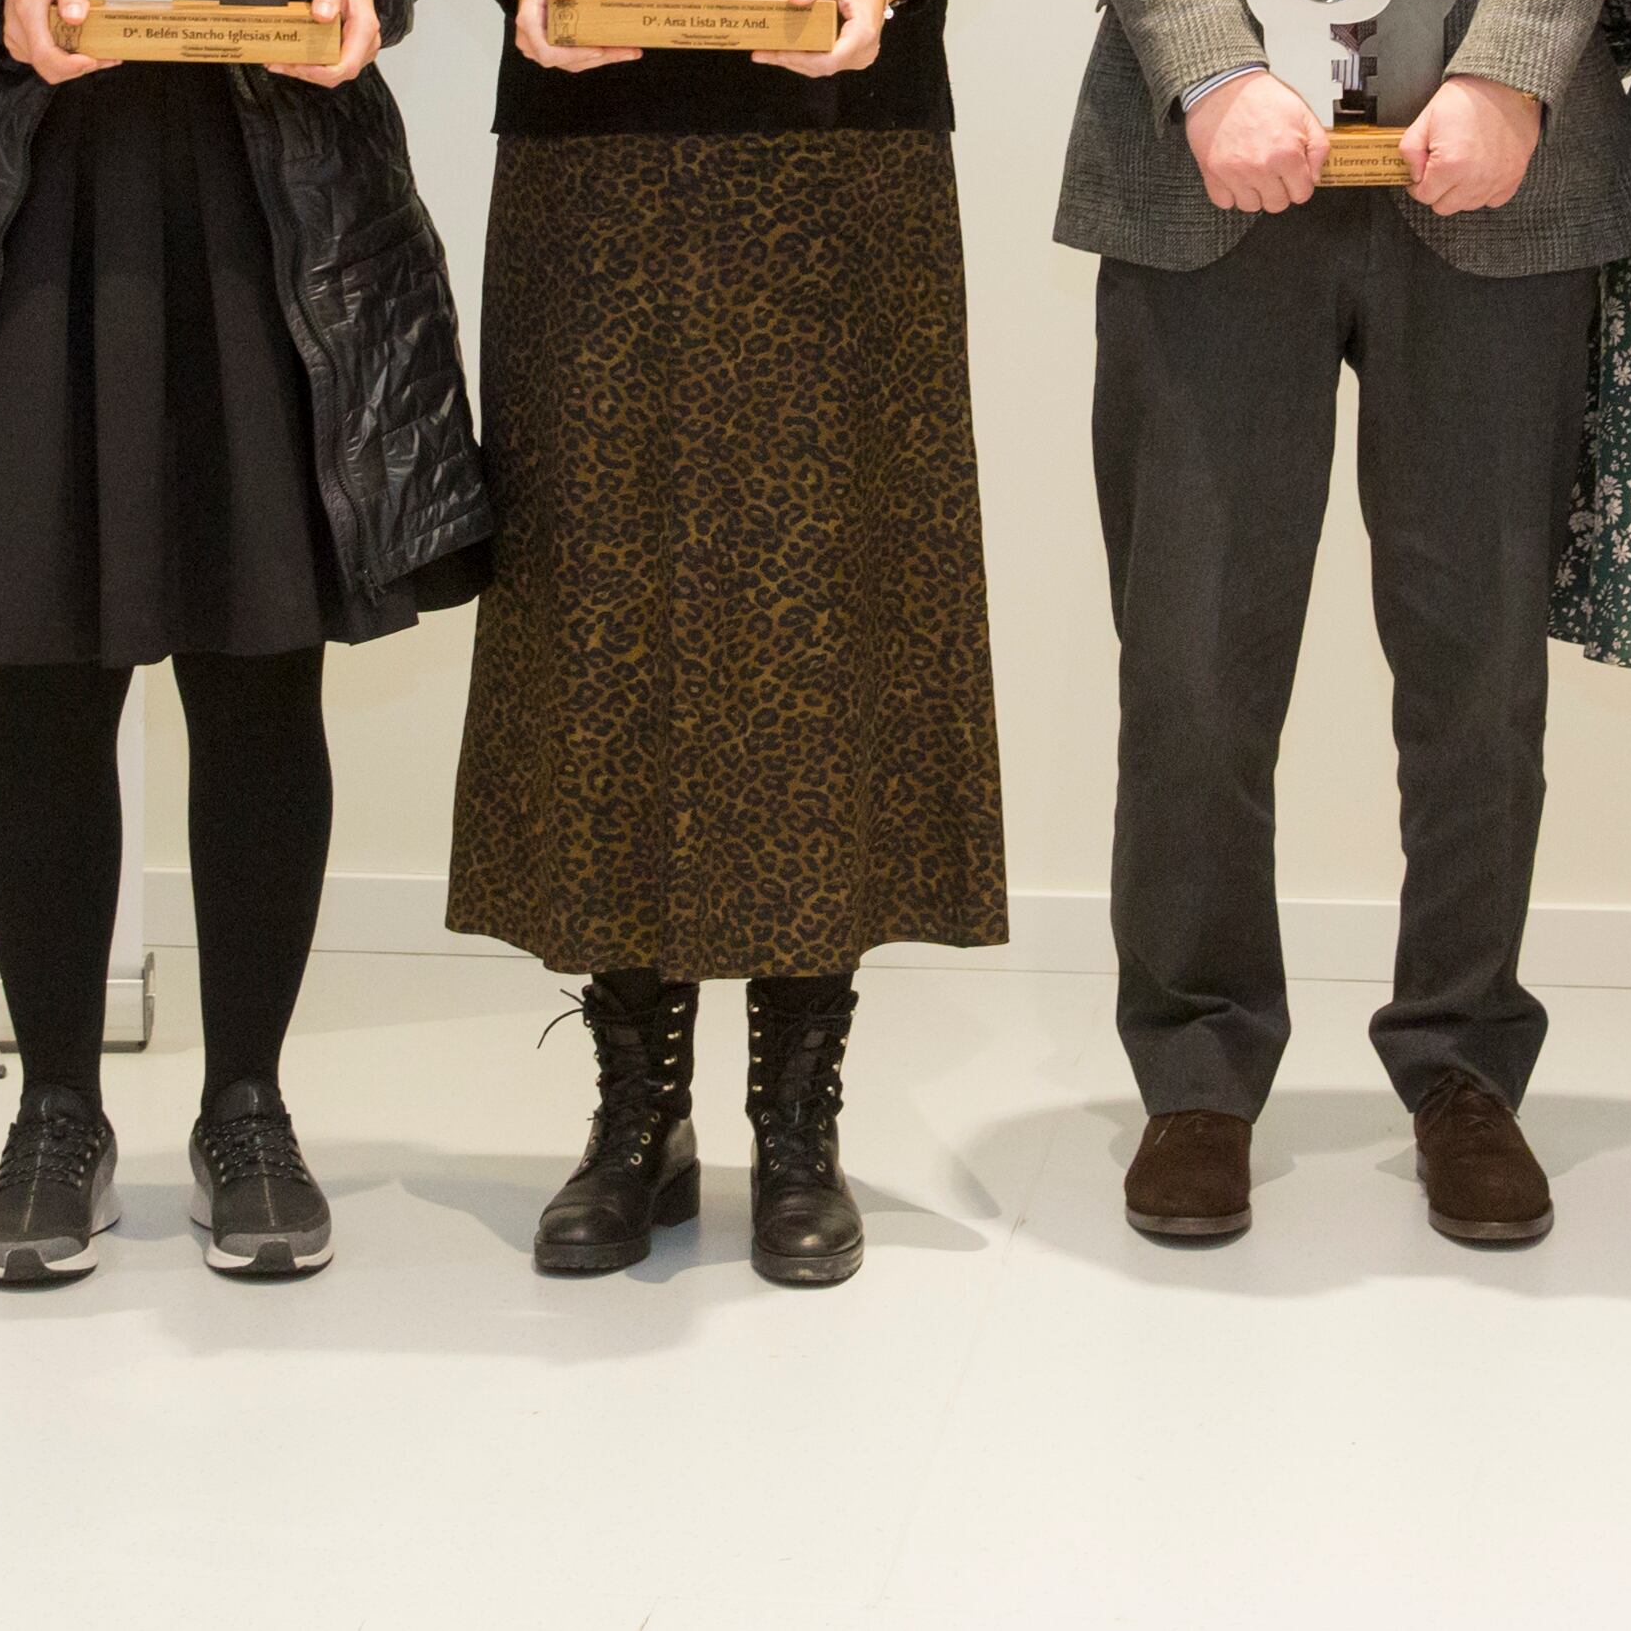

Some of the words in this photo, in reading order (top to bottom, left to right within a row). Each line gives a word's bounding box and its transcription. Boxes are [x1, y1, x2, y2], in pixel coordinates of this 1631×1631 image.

[664, 16, 686, 28] Ana
[690, 16, 716, 28] Lista
[719, 17, 739, 29] Paz
[742, 17, 770, 29] And.
[145, 27, 178, 39] Belén
[181, 27, 225, 41] Sancho
[228, 28, 270, 43] Iglesias
[273, 30, 301, 42] And.
[1333, 156, 1379, 167] Herrero
